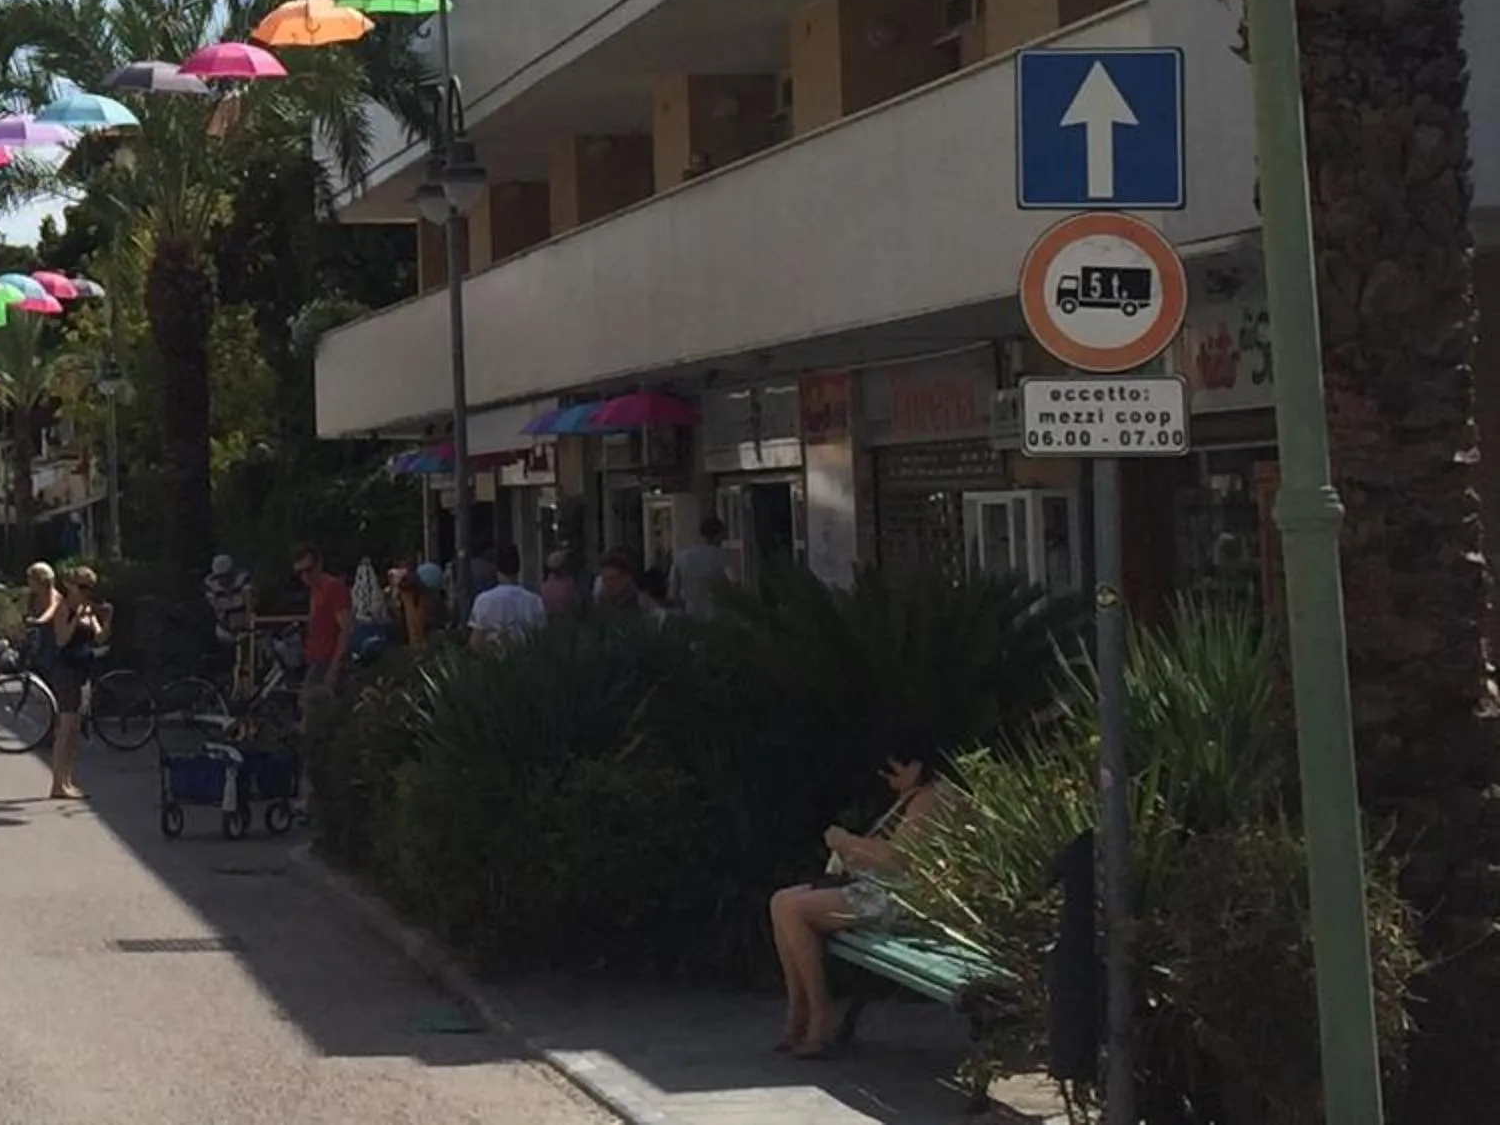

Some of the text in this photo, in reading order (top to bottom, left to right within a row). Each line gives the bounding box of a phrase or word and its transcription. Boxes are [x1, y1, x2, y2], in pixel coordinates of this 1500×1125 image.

[1090, 272, 1102, 298] 5
[1038, 408, 1172, 427] mezzi coop
[1027, 429, 1092, 447] 06.00
[1119, 429, 1184, 447] 07.00
